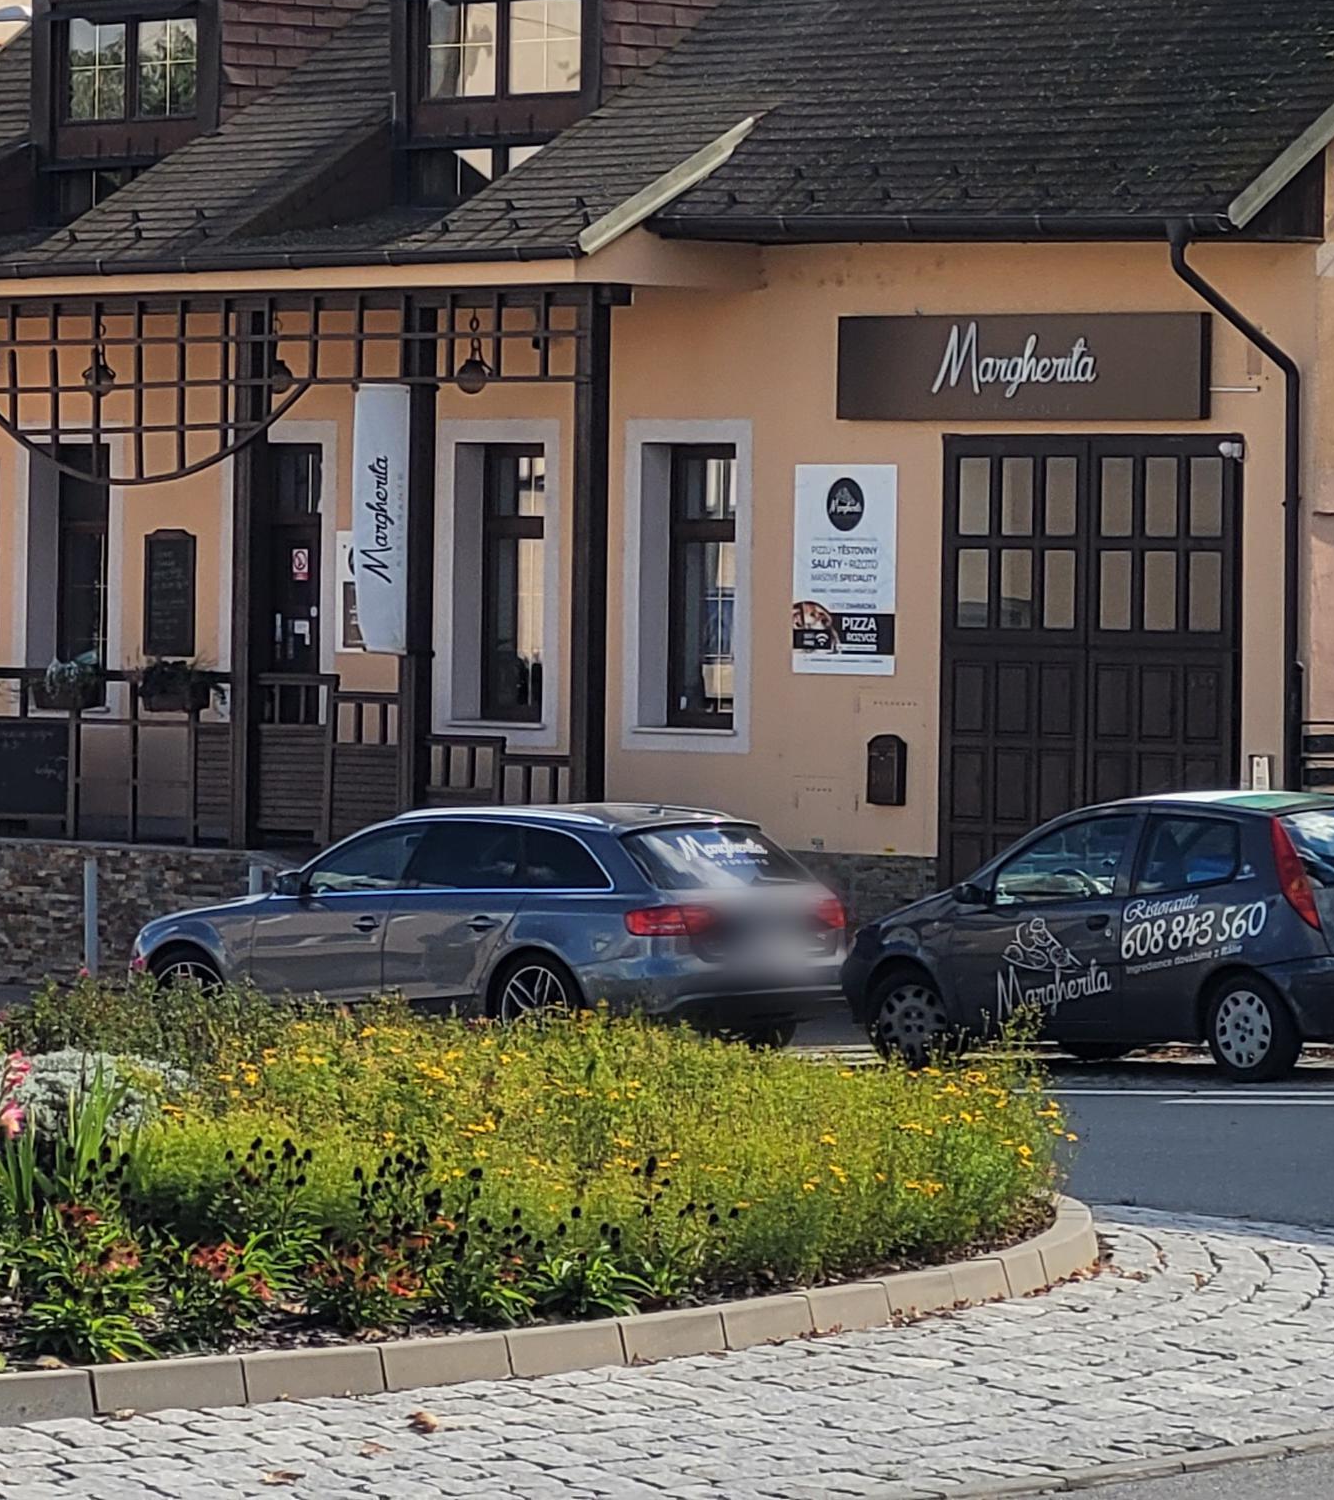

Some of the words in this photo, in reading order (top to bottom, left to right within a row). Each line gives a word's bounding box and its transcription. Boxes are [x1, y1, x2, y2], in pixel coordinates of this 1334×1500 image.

[932, 321, 1097, 398] Margherita
[359, 455, 395, 584] Margherita
[842, 617, 878, 631] PIZZA
[1121, 919, 1166, 959] 608
[1168, 910, 1215, 951] 843
[1217, 901, 1267, 942] 560
[1123, 893, 1200, 923] Ristorante
[996, 958, 1112, 1021] Margherita
